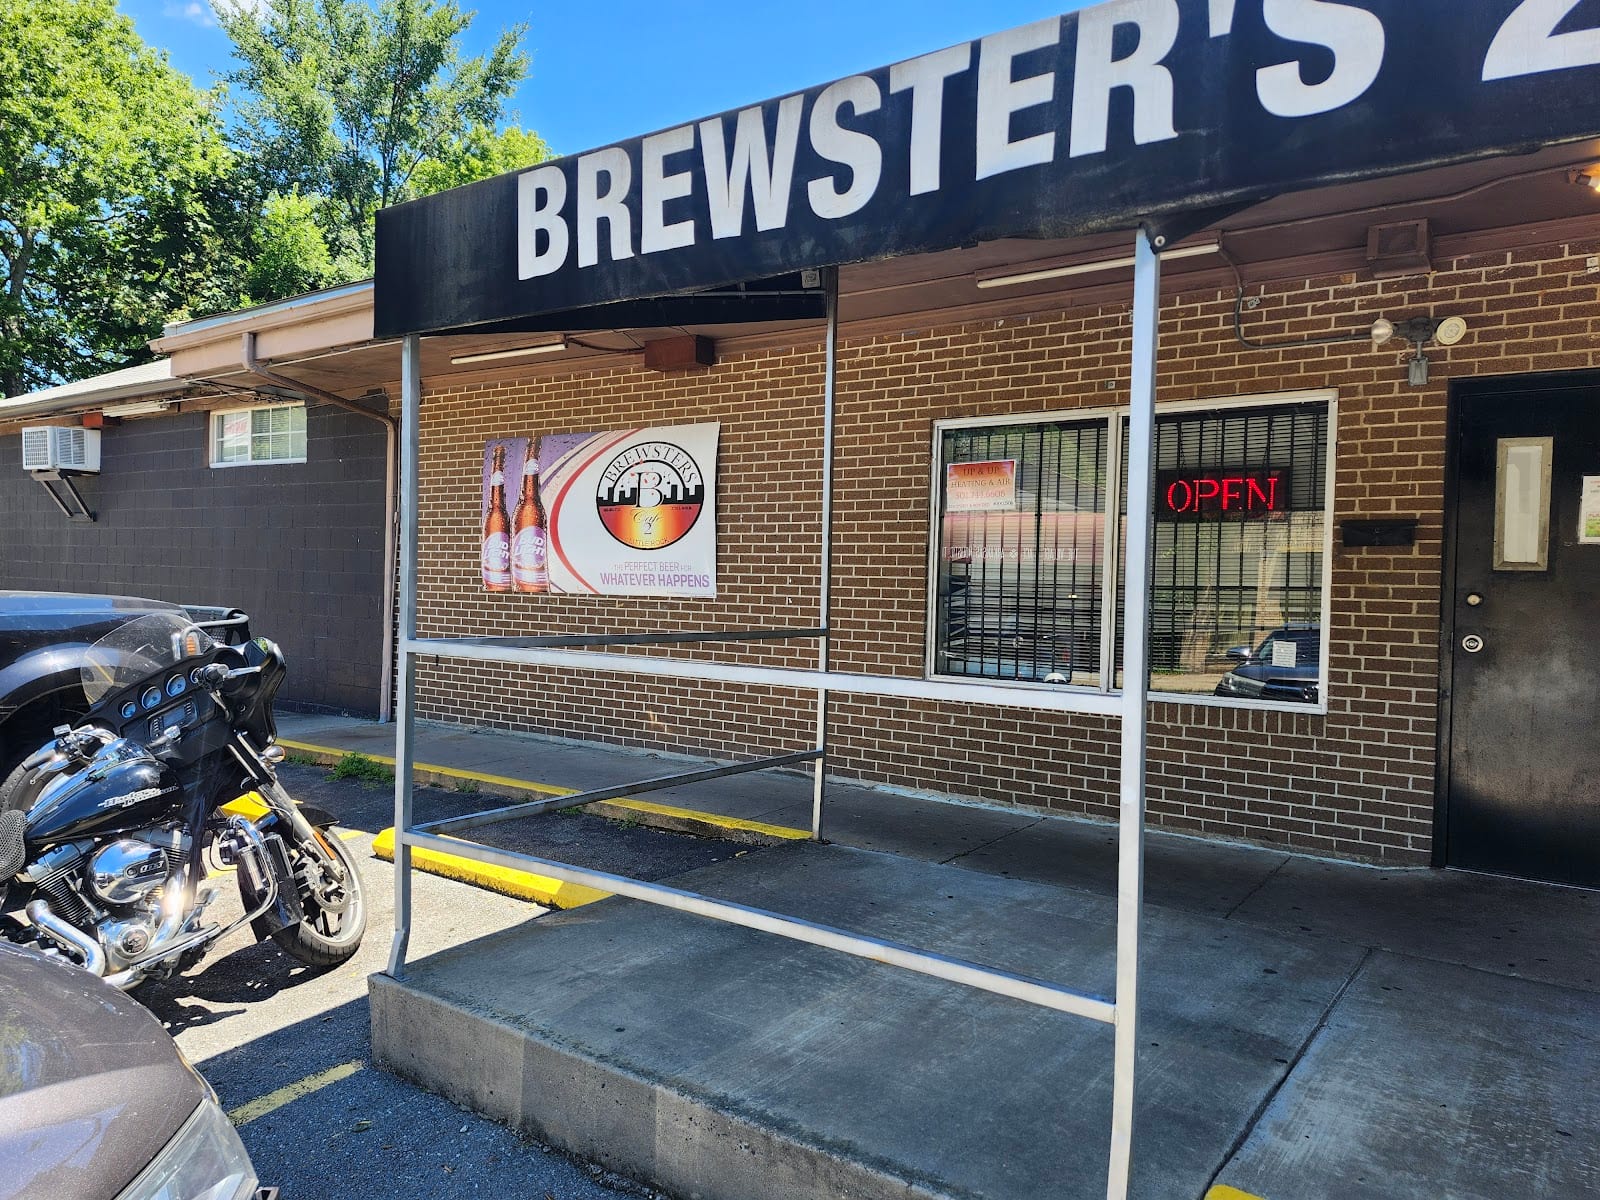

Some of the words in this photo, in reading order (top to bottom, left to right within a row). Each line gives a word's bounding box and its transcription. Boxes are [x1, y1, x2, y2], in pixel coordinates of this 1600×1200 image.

[605, 445, 697, 482] BREWSTERS
[963, 467, 976, 476] UP
[987, 466, 1000, 474] UP
[635, 471, 663, 508] B
[951, 480, 987, 488] HEATING
[997, 478, 1011, 486] AIR
[1167, 478, 1278, 512] OPEN
[643, 522, 652, 535] 2
[624, 561, 657, 572] PERFECT
[659, 561, 680, 572] BEER
[600, 573, 656, 586] WHATEVER
[658, 574, 710, 588] HAPPENS
